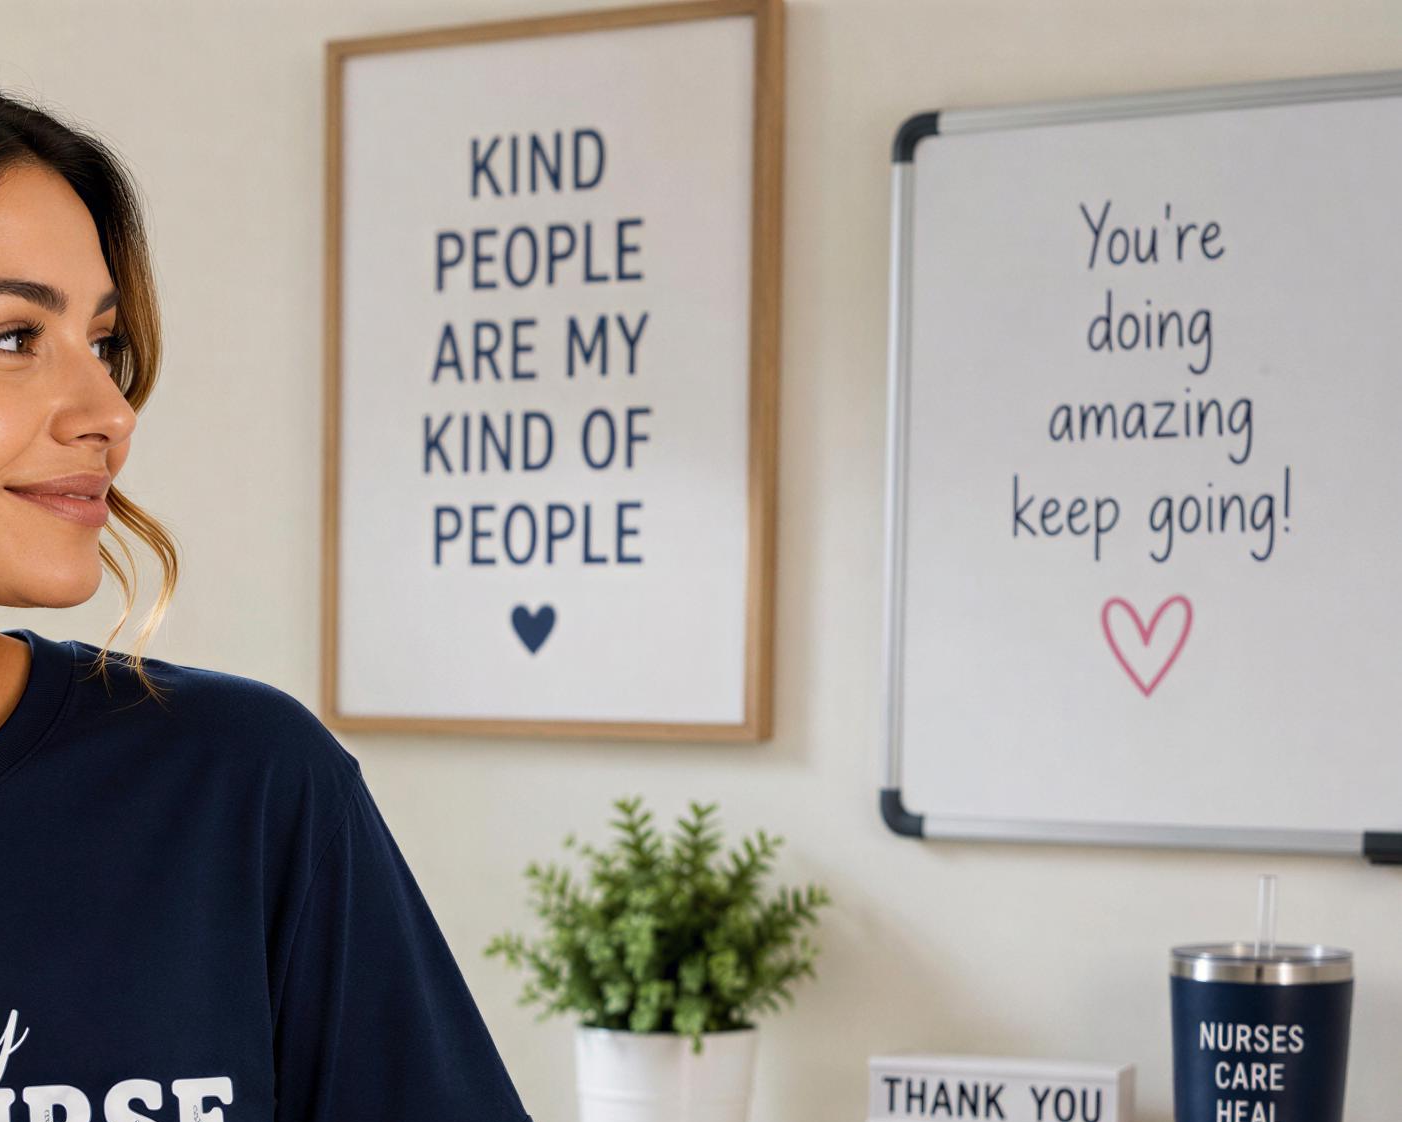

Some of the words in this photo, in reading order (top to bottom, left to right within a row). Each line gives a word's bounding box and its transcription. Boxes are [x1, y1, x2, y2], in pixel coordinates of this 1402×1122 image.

[471, 128, 606, 198] KIND
[436, 218, 643, 292] PEOPLE
[1080, 202, 1225, 269] You're
[432, 318, 537, 383] ARE
[567, 313, 649, 378] MY
[1088, 290, 1212, 375] doing
[424, 411, 554, 473] KIND
[581, 407, 652, 470] OF
[1049, 389, 1254, 466] amazing
[434, 501, 643, 566] PEOPLE
[1013, 475, 1120, 561] keep
[1148, 465, 1292, 563] going!
[1199, 1020, 1304, 1053] NURSES
[884, 1077, 1005, 1119] THANK
[1214, 1061, 1285, 1091] CARE
